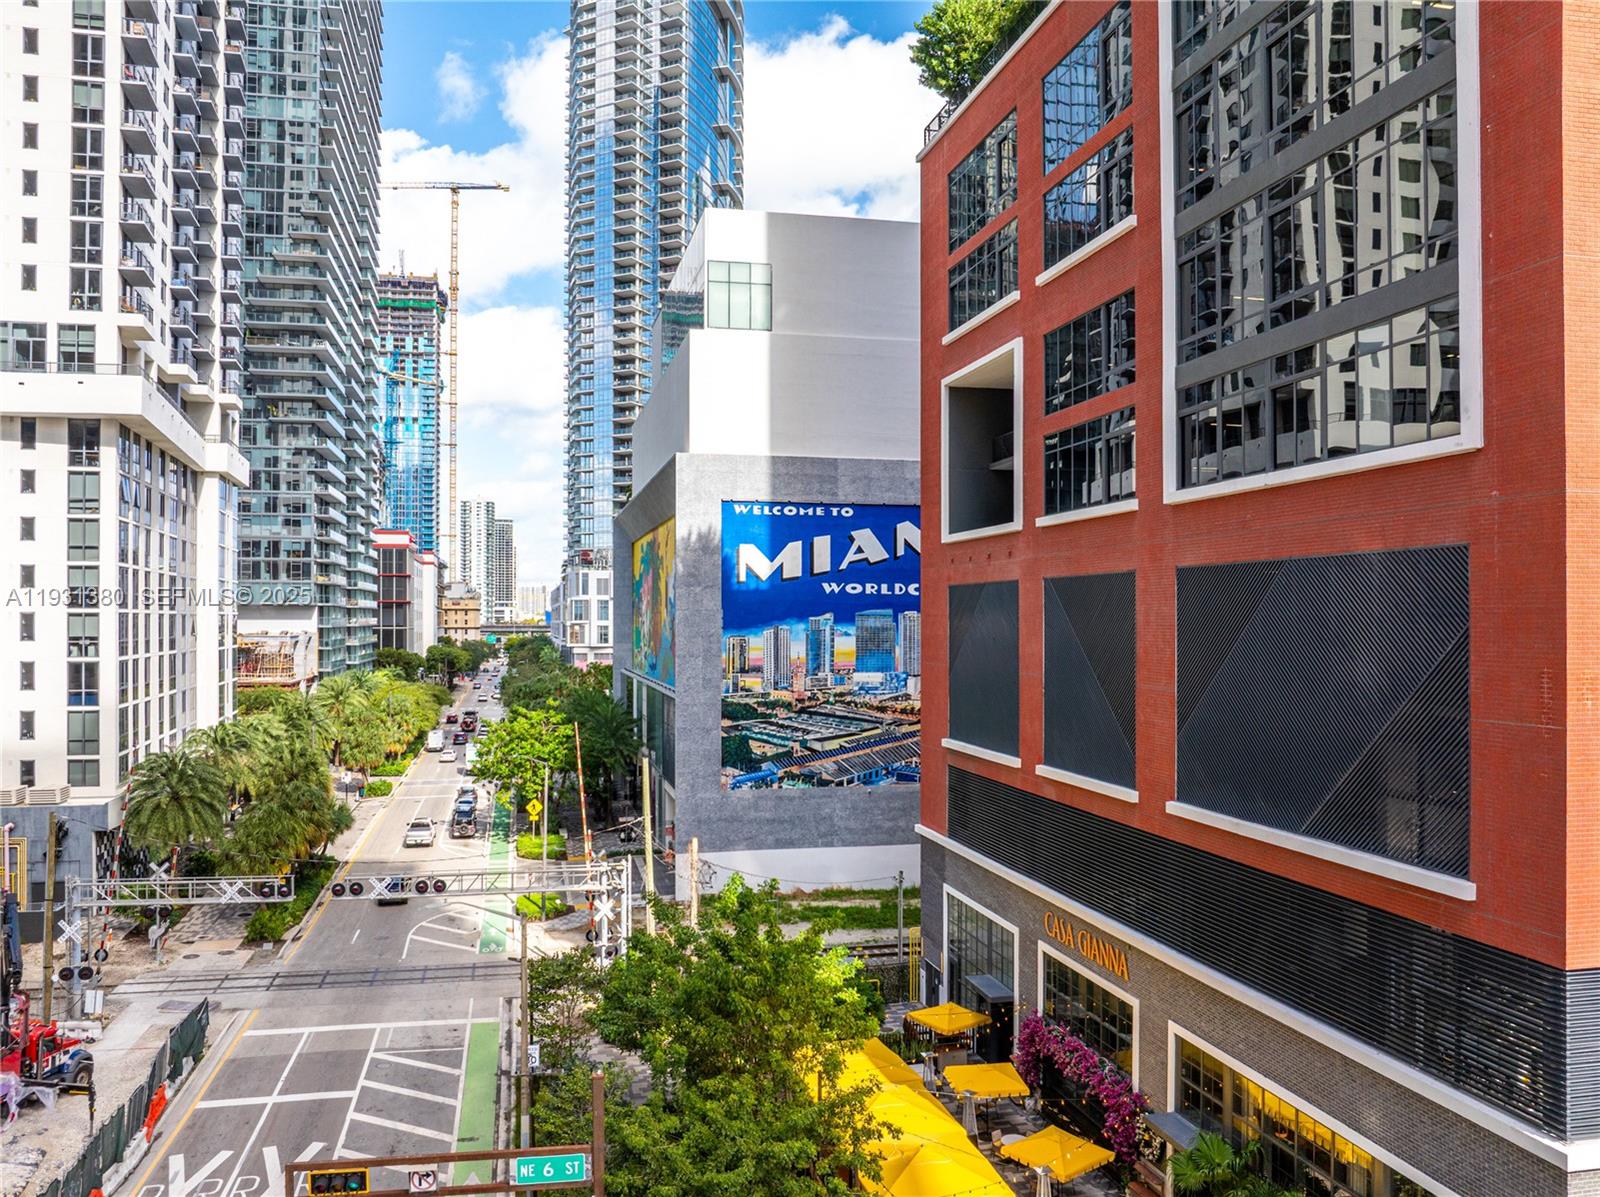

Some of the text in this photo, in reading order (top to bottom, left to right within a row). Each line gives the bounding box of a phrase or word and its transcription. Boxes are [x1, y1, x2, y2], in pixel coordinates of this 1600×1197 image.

[733, 504, 854, 517] WELCOME TO
[1044, 911, 1129, 981] CASA GIANNA
[520, 1161, 580, 1177] NE 6 ST
